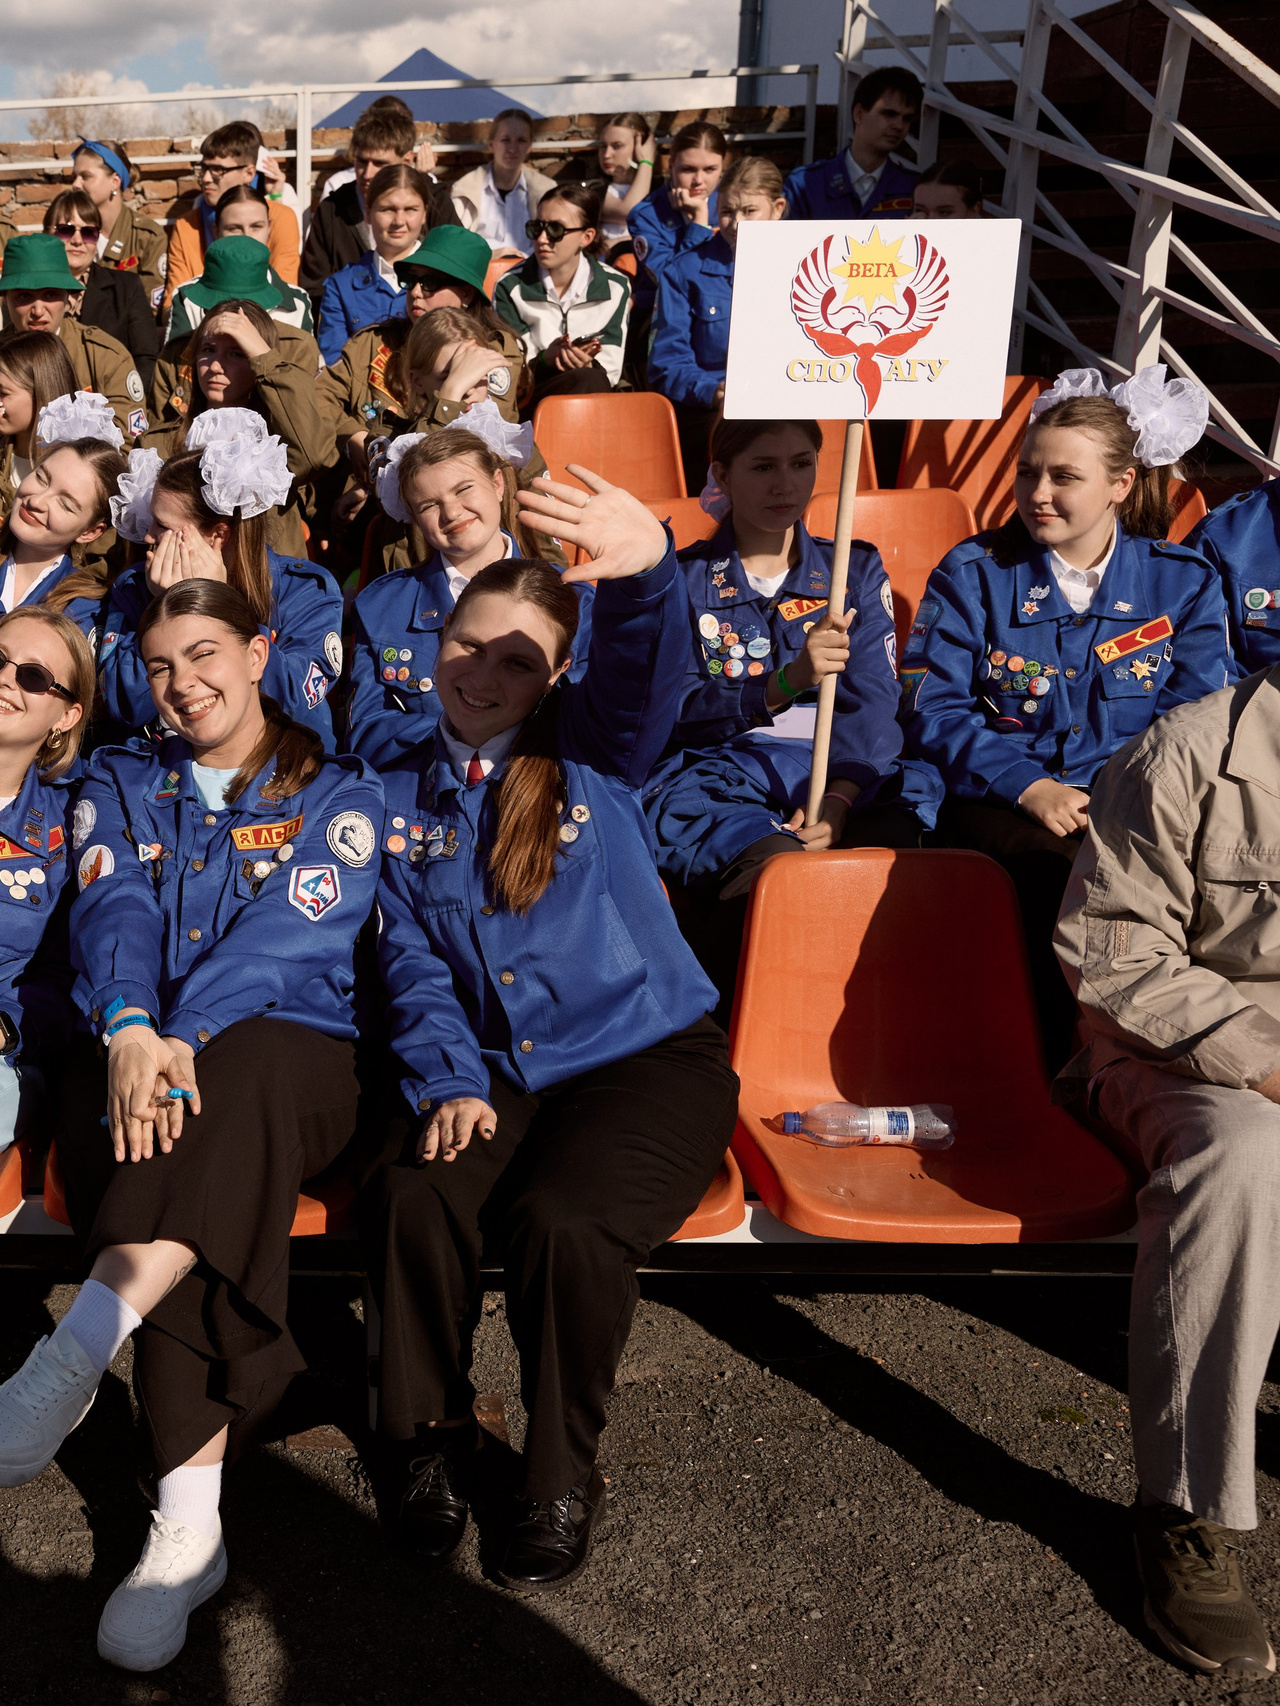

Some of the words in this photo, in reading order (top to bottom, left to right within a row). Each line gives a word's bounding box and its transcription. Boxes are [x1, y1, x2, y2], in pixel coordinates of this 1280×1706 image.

[847, 262, 899, 278] ВЕГА
[786, 358, 853, 383] СПО
[883, 358, 950, 383] АГУ
